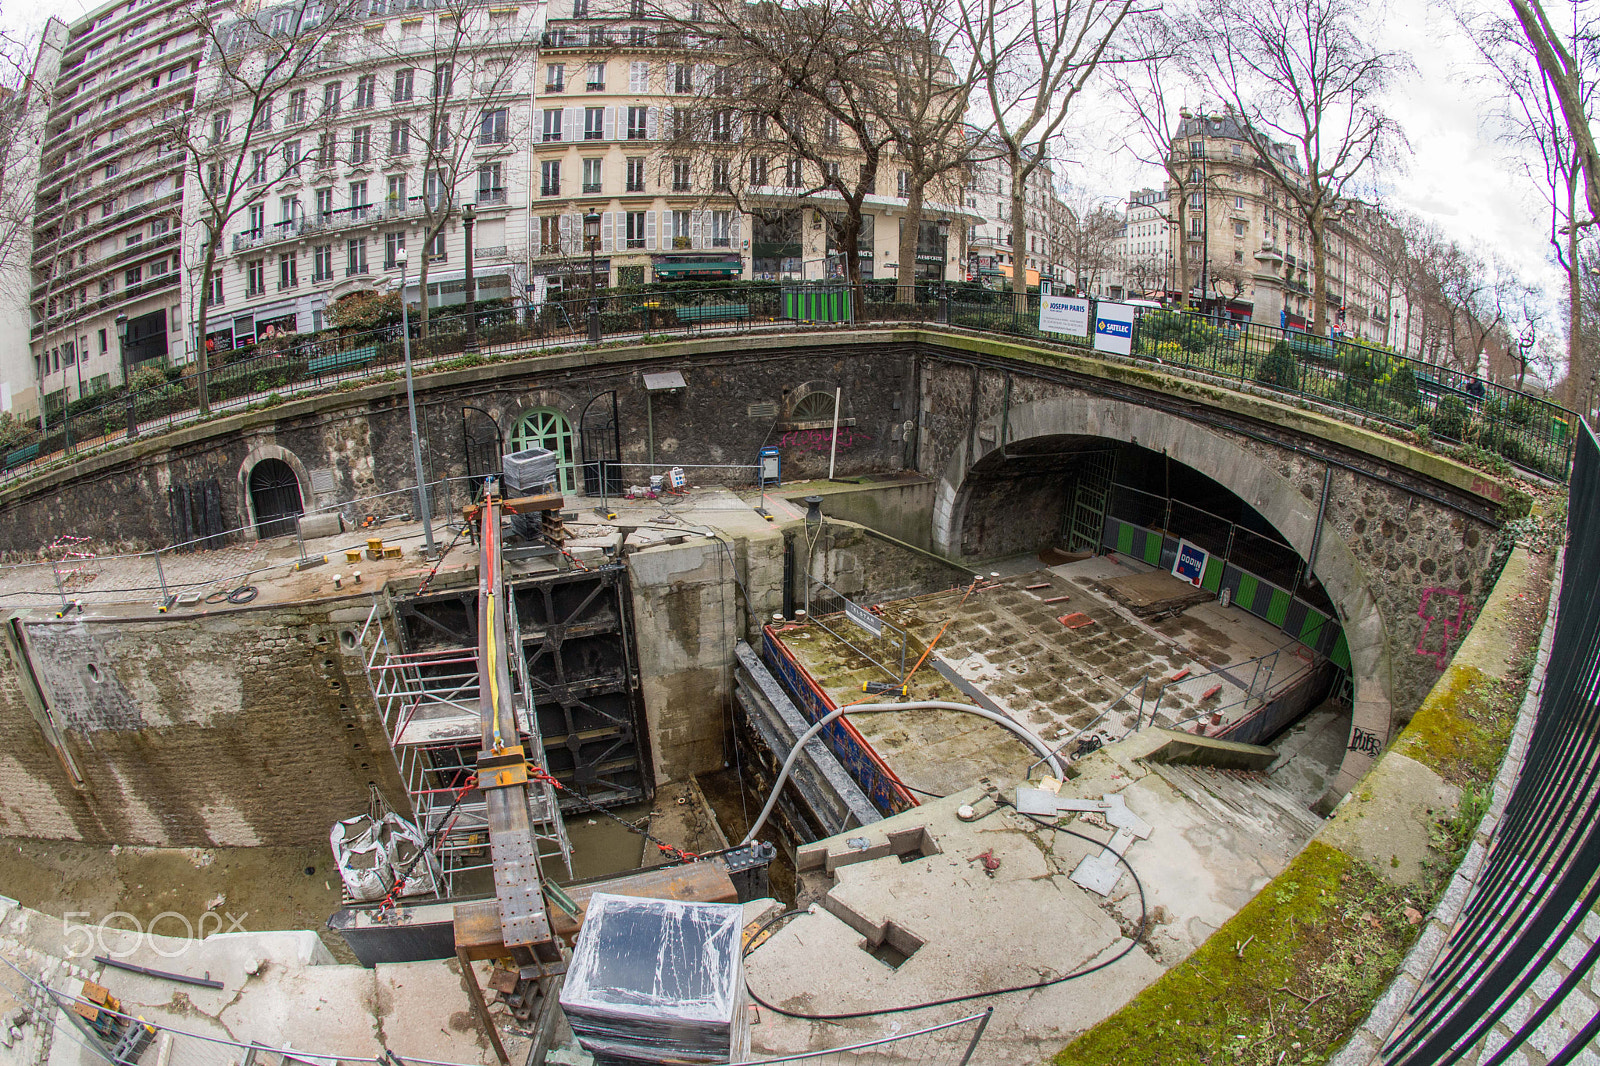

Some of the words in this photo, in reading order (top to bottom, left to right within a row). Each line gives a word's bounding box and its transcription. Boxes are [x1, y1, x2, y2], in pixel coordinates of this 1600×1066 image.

[1050, 303, 1069, 311] JOSEPH
[1069, 304, 1085, 312] PARIS
[1106, 323, 1129, 333] SATELEC
[1181, 553, 1202, 569] DODIN
[850, 605, 875, 624] TELSTAR
